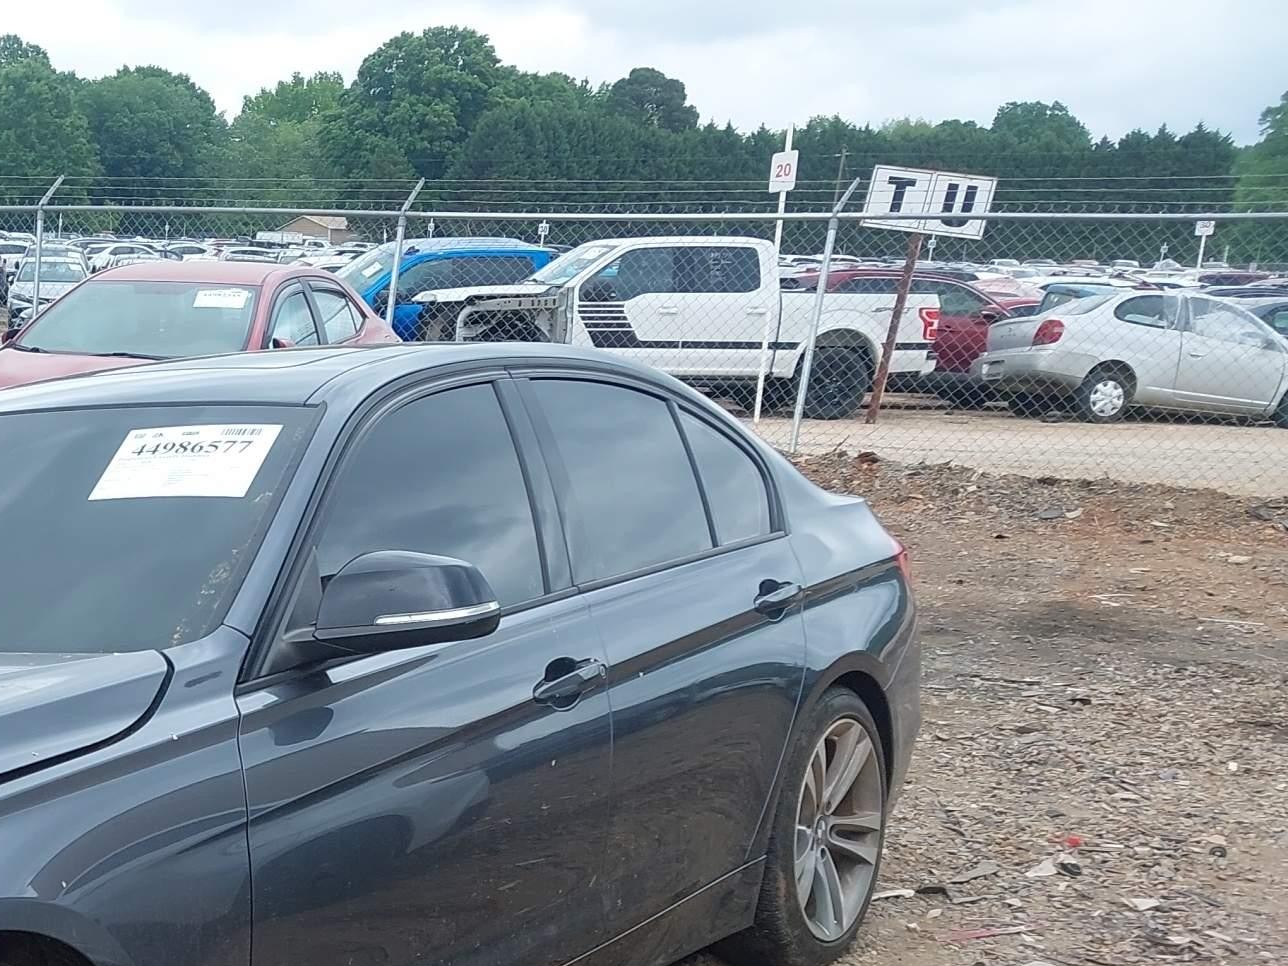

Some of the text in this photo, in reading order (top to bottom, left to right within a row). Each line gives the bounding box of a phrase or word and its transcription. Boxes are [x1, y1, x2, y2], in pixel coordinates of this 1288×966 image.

[776, 163, 792, 178] 20
[887, 176, 979, 228] T U
[131, 440, 254, 456] 44986577
